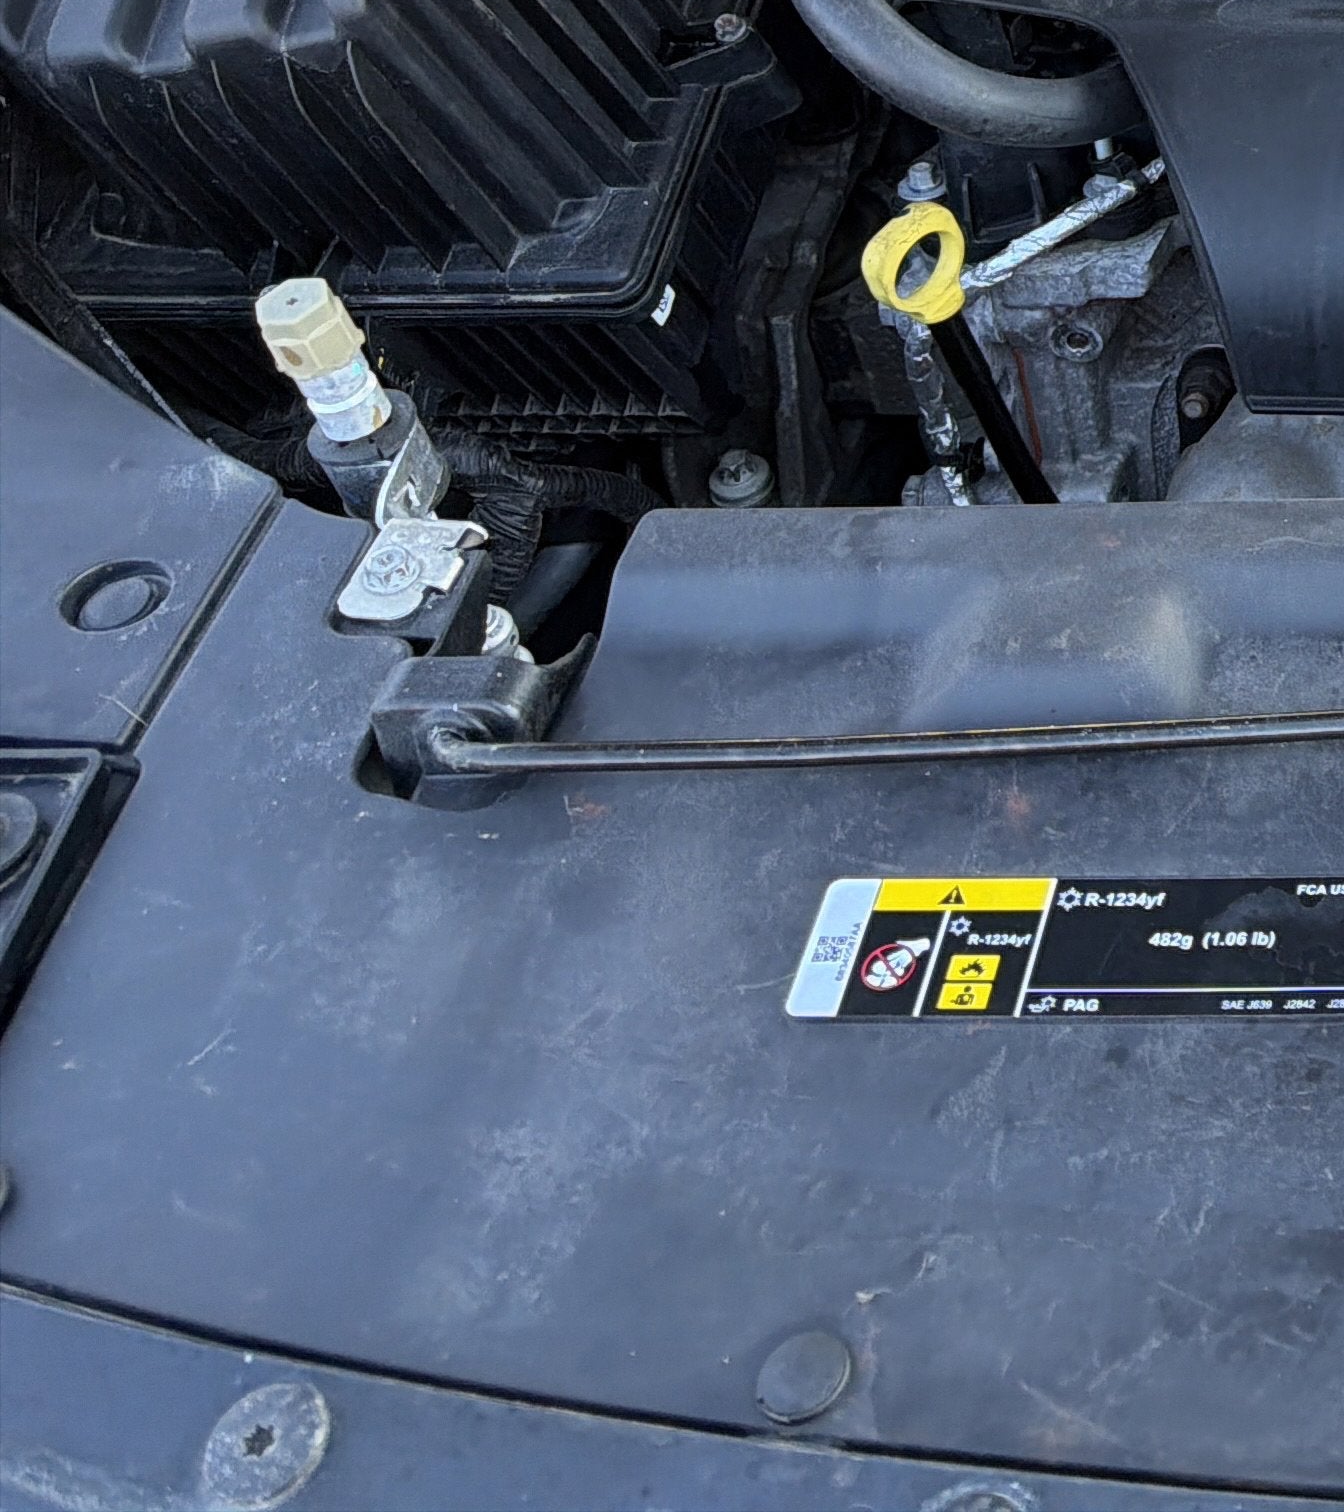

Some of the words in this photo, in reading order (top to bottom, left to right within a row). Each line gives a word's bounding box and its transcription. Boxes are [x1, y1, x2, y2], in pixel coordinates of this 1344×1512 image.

[1296, 884, 1327, 896] FCA
[1084, 892, 1166, 910] R-1234yf
[967, 934, 1032, 947] R-1234yf
[1148, 932, 1194, 950] 482g
[1202, 931, 1248, 949] (1.06
[1250, 931, 1276, 949] lb)
[1063, 998, 1100, 1012] PAG
[1221, 999, 1245, 1011] SAE
[1246, 999, 1273, 1011] J639
